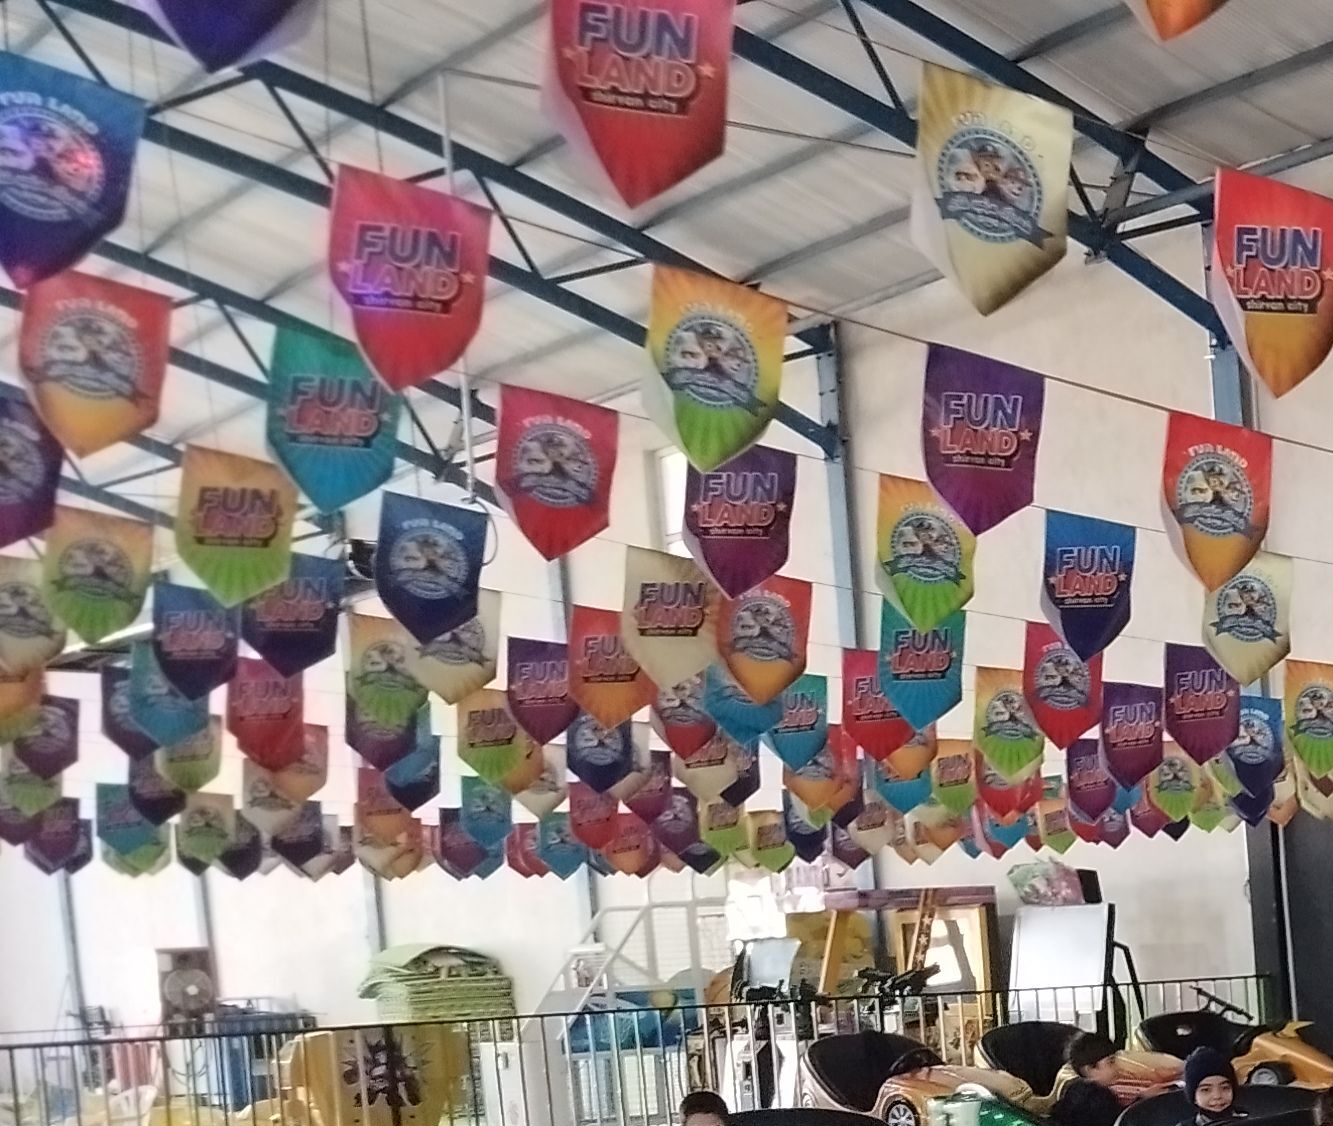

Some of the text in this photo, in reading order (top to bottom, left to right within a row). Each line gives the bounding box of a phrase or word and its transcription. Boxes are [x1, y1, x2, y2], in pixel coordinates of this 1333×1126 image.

[578, 2, 698, 63] FUN
[577, 51, 697, 98] LAND
[354, 220, 461, 272] FUN
[1234, 225, 1321, 270] FUN
[348, 261, 459, 299] LAND
[1234, 267, 1321, 299] LAND
[287, 374, 380, 410] FUN
[941, 392, 1023, 432] FUN
[940, 427, 1018, 456] LAND
[1189, 444, 1214, 457] FUN
[198, 486, 279, 516] FUN
[700, 472, 778, 504] FUN
[698, 502, 776, 527] LAND
[1057, 545, 1121, 575] FUN
[640, 582, 705, 610] FUN
[1054, 573, 1119, 598] LAND
[893, 627, 952, 653] FUN
[516, 661, 568, 684] FUN
[892, 651, 950, 675] LAND
[855, 676, 885, 700] FU
[1175, 668, 1227, 698] FUN
[1109, 702, 1157, 728] FUN
